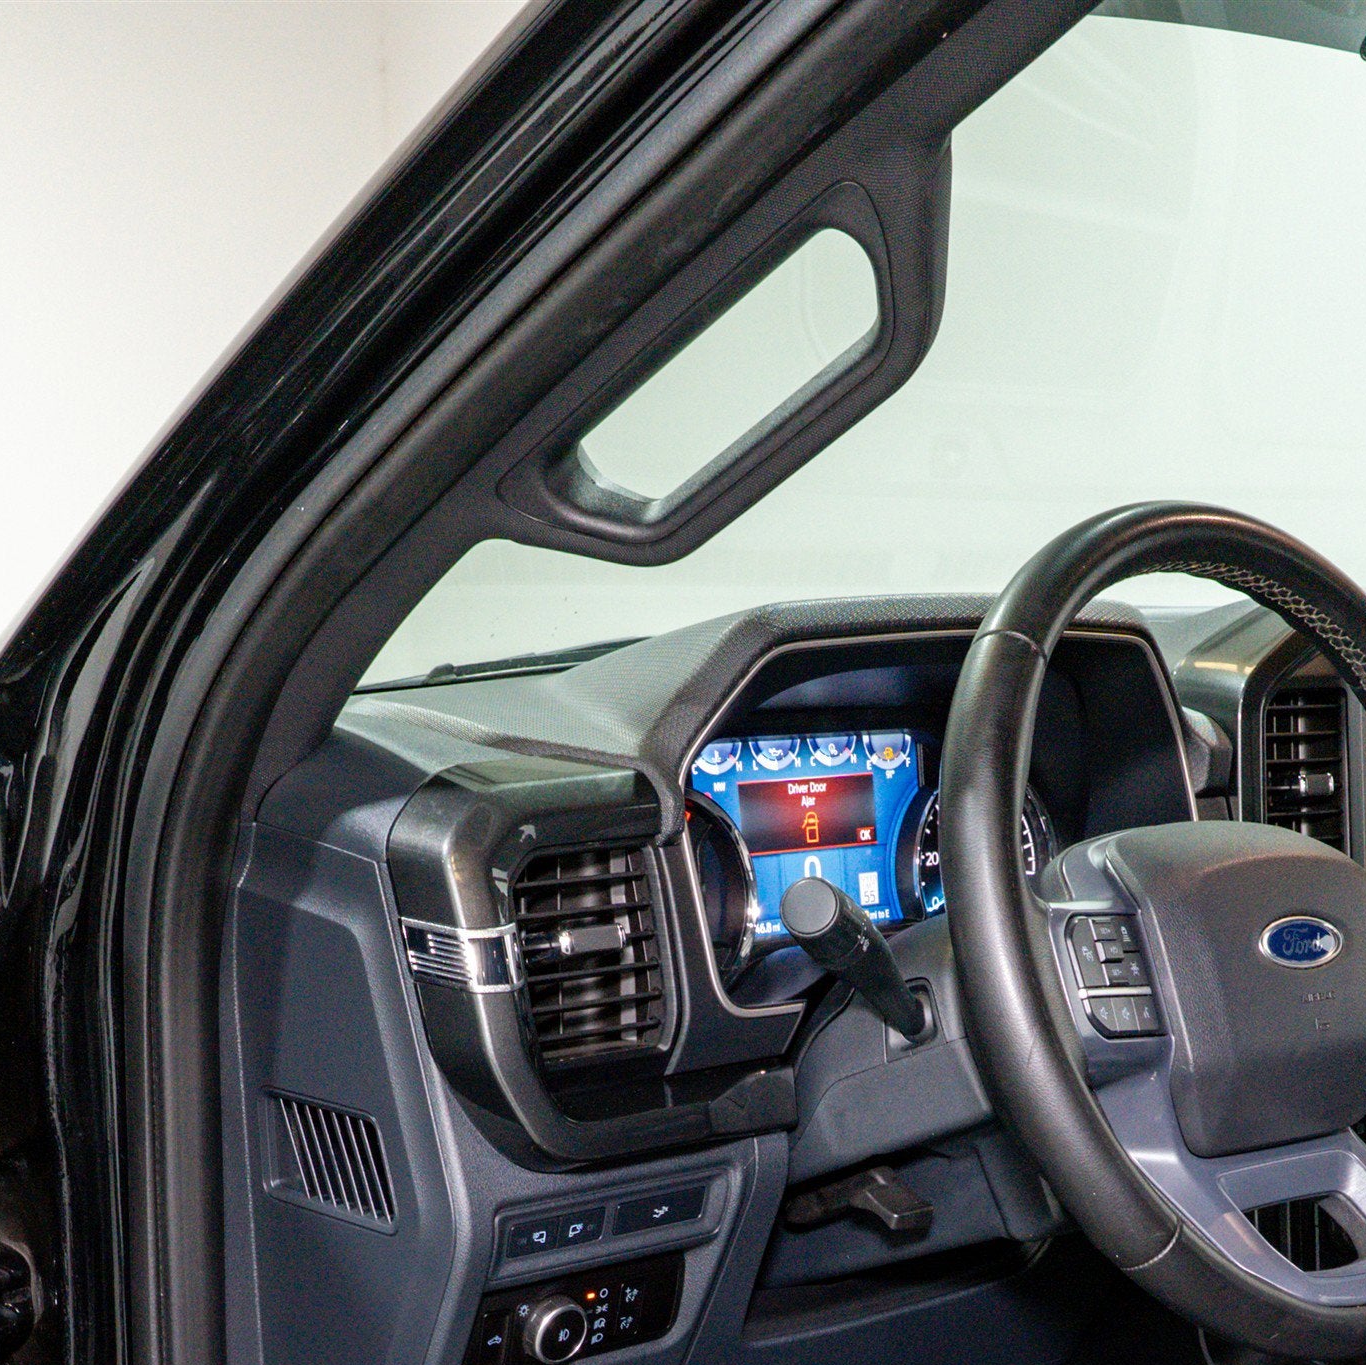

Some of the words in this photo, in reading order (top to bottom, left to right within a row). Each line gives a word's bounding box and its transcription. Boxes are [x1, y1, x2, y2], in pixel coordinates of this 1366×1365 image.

[787, 783, 809, 795] Driver
[810, 781, 827, 793] Door
[801, 795, 816, 808] Ajar
[859, 829, 871, 841] OK
[925, 851, 940, 867] 20
[864, 890, 876, 904] 55
[1282, 928, 1323, 956] Ford
